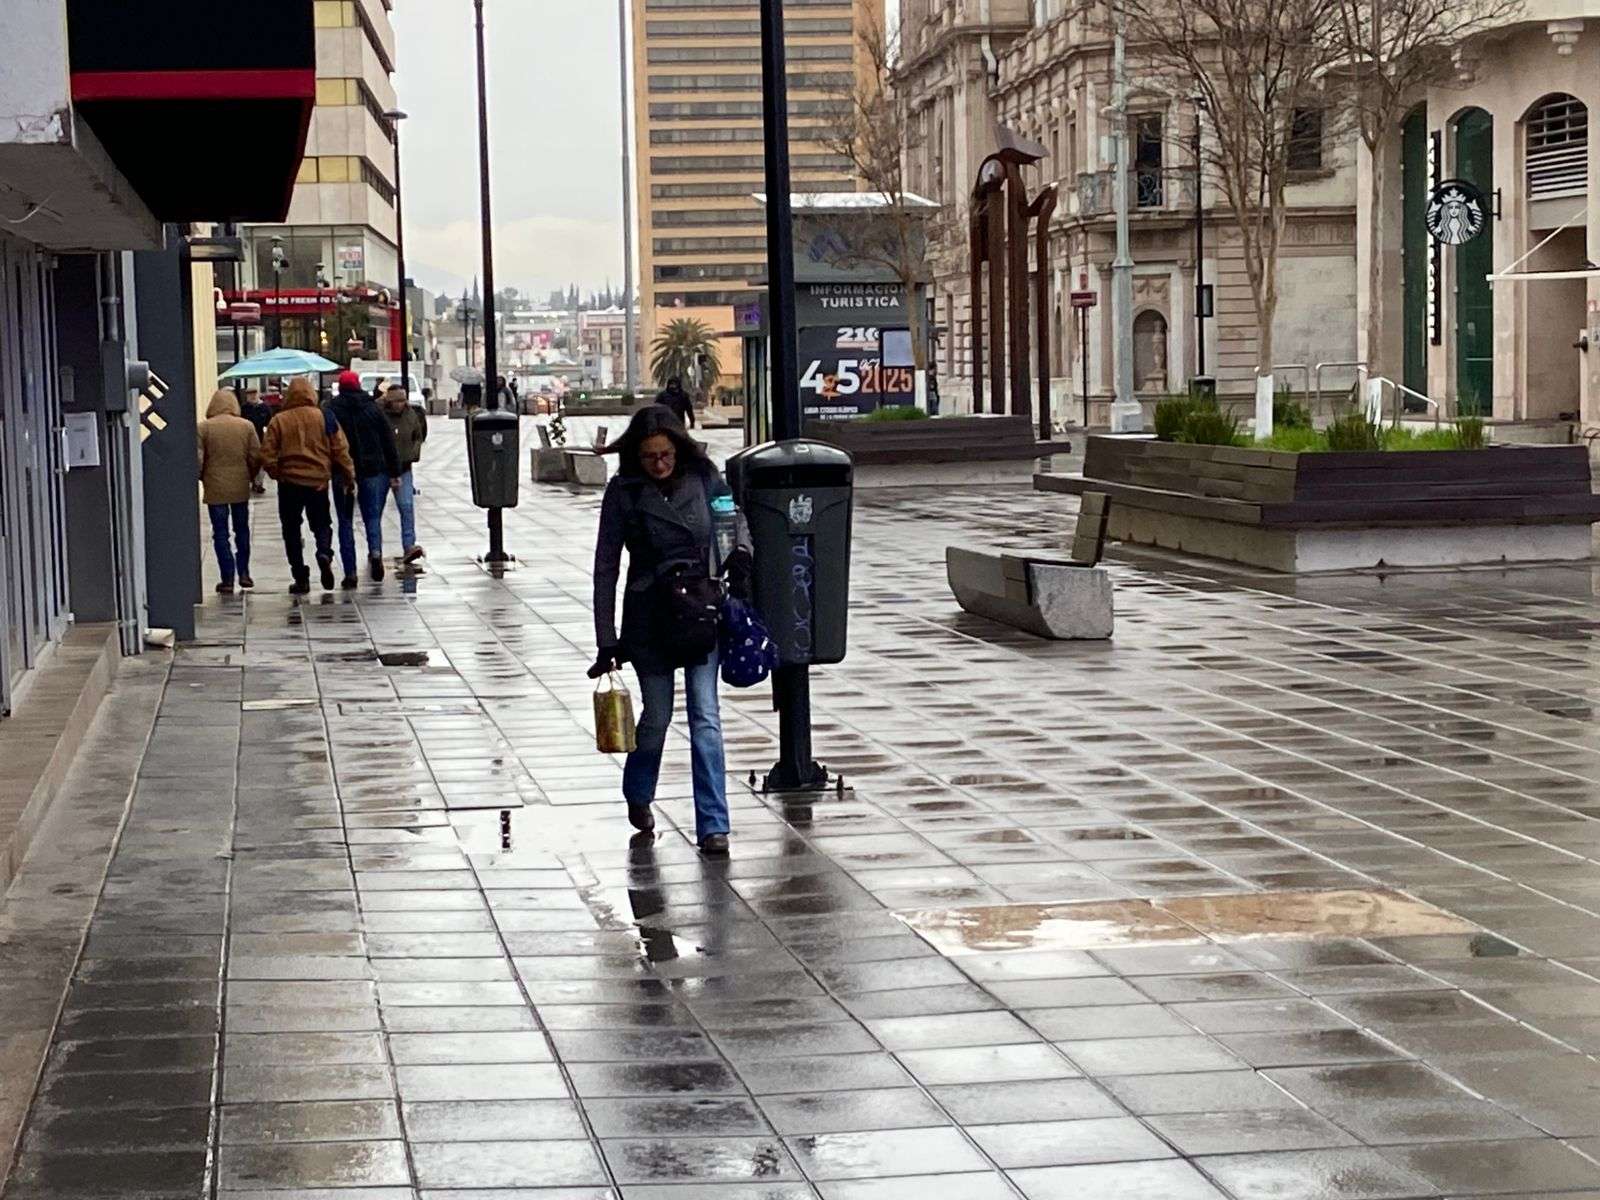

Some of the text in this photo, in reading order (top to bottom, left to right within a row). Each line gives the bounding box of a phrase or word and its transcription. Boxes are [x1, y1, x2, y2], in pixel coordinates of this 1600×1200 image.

[820, 296, 899, 308] TURISTICA
[800, 360, 824, 394] 4
[837, 360, 860, 394] 5
[861, 368, 913, 393] 2025
